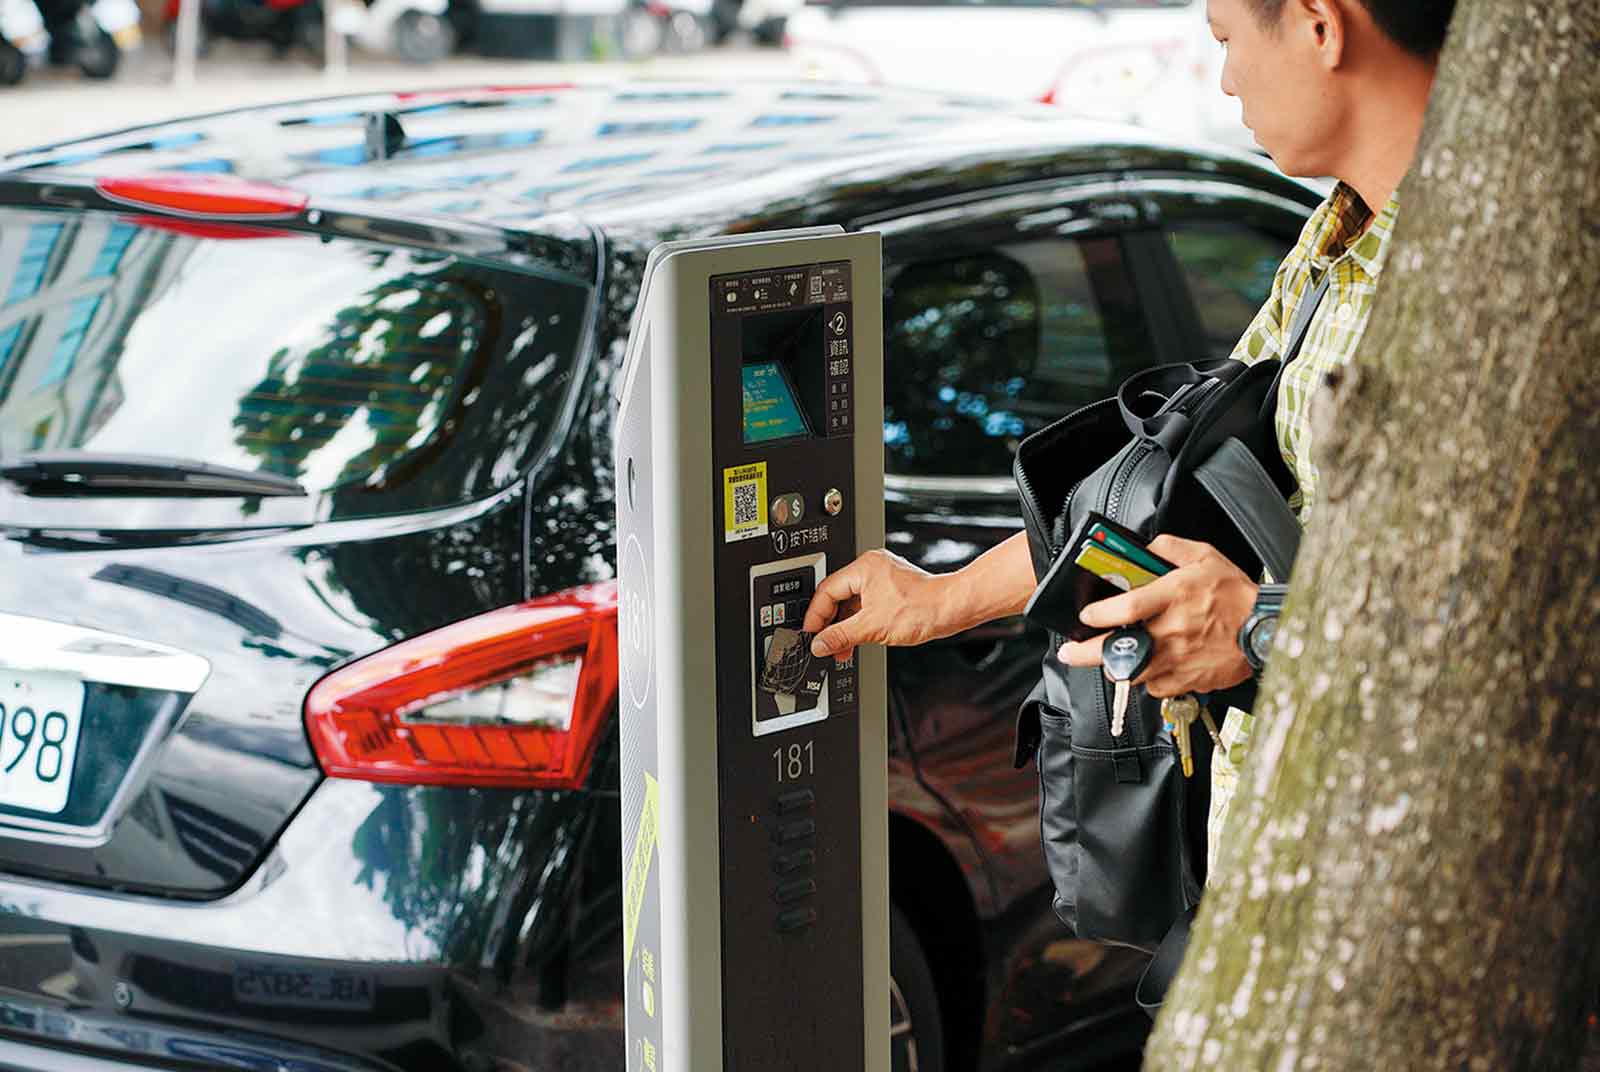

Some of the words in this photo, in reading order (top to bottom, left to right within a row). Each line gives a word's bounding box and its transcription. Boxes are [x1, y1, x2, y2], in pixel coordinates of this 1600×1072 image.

[830, 339, 848, 357] 資訊
[830, 359, 849, 376] 確認
[0, 702, 68, 782] 98
[772, 740, 815, 782] 181
